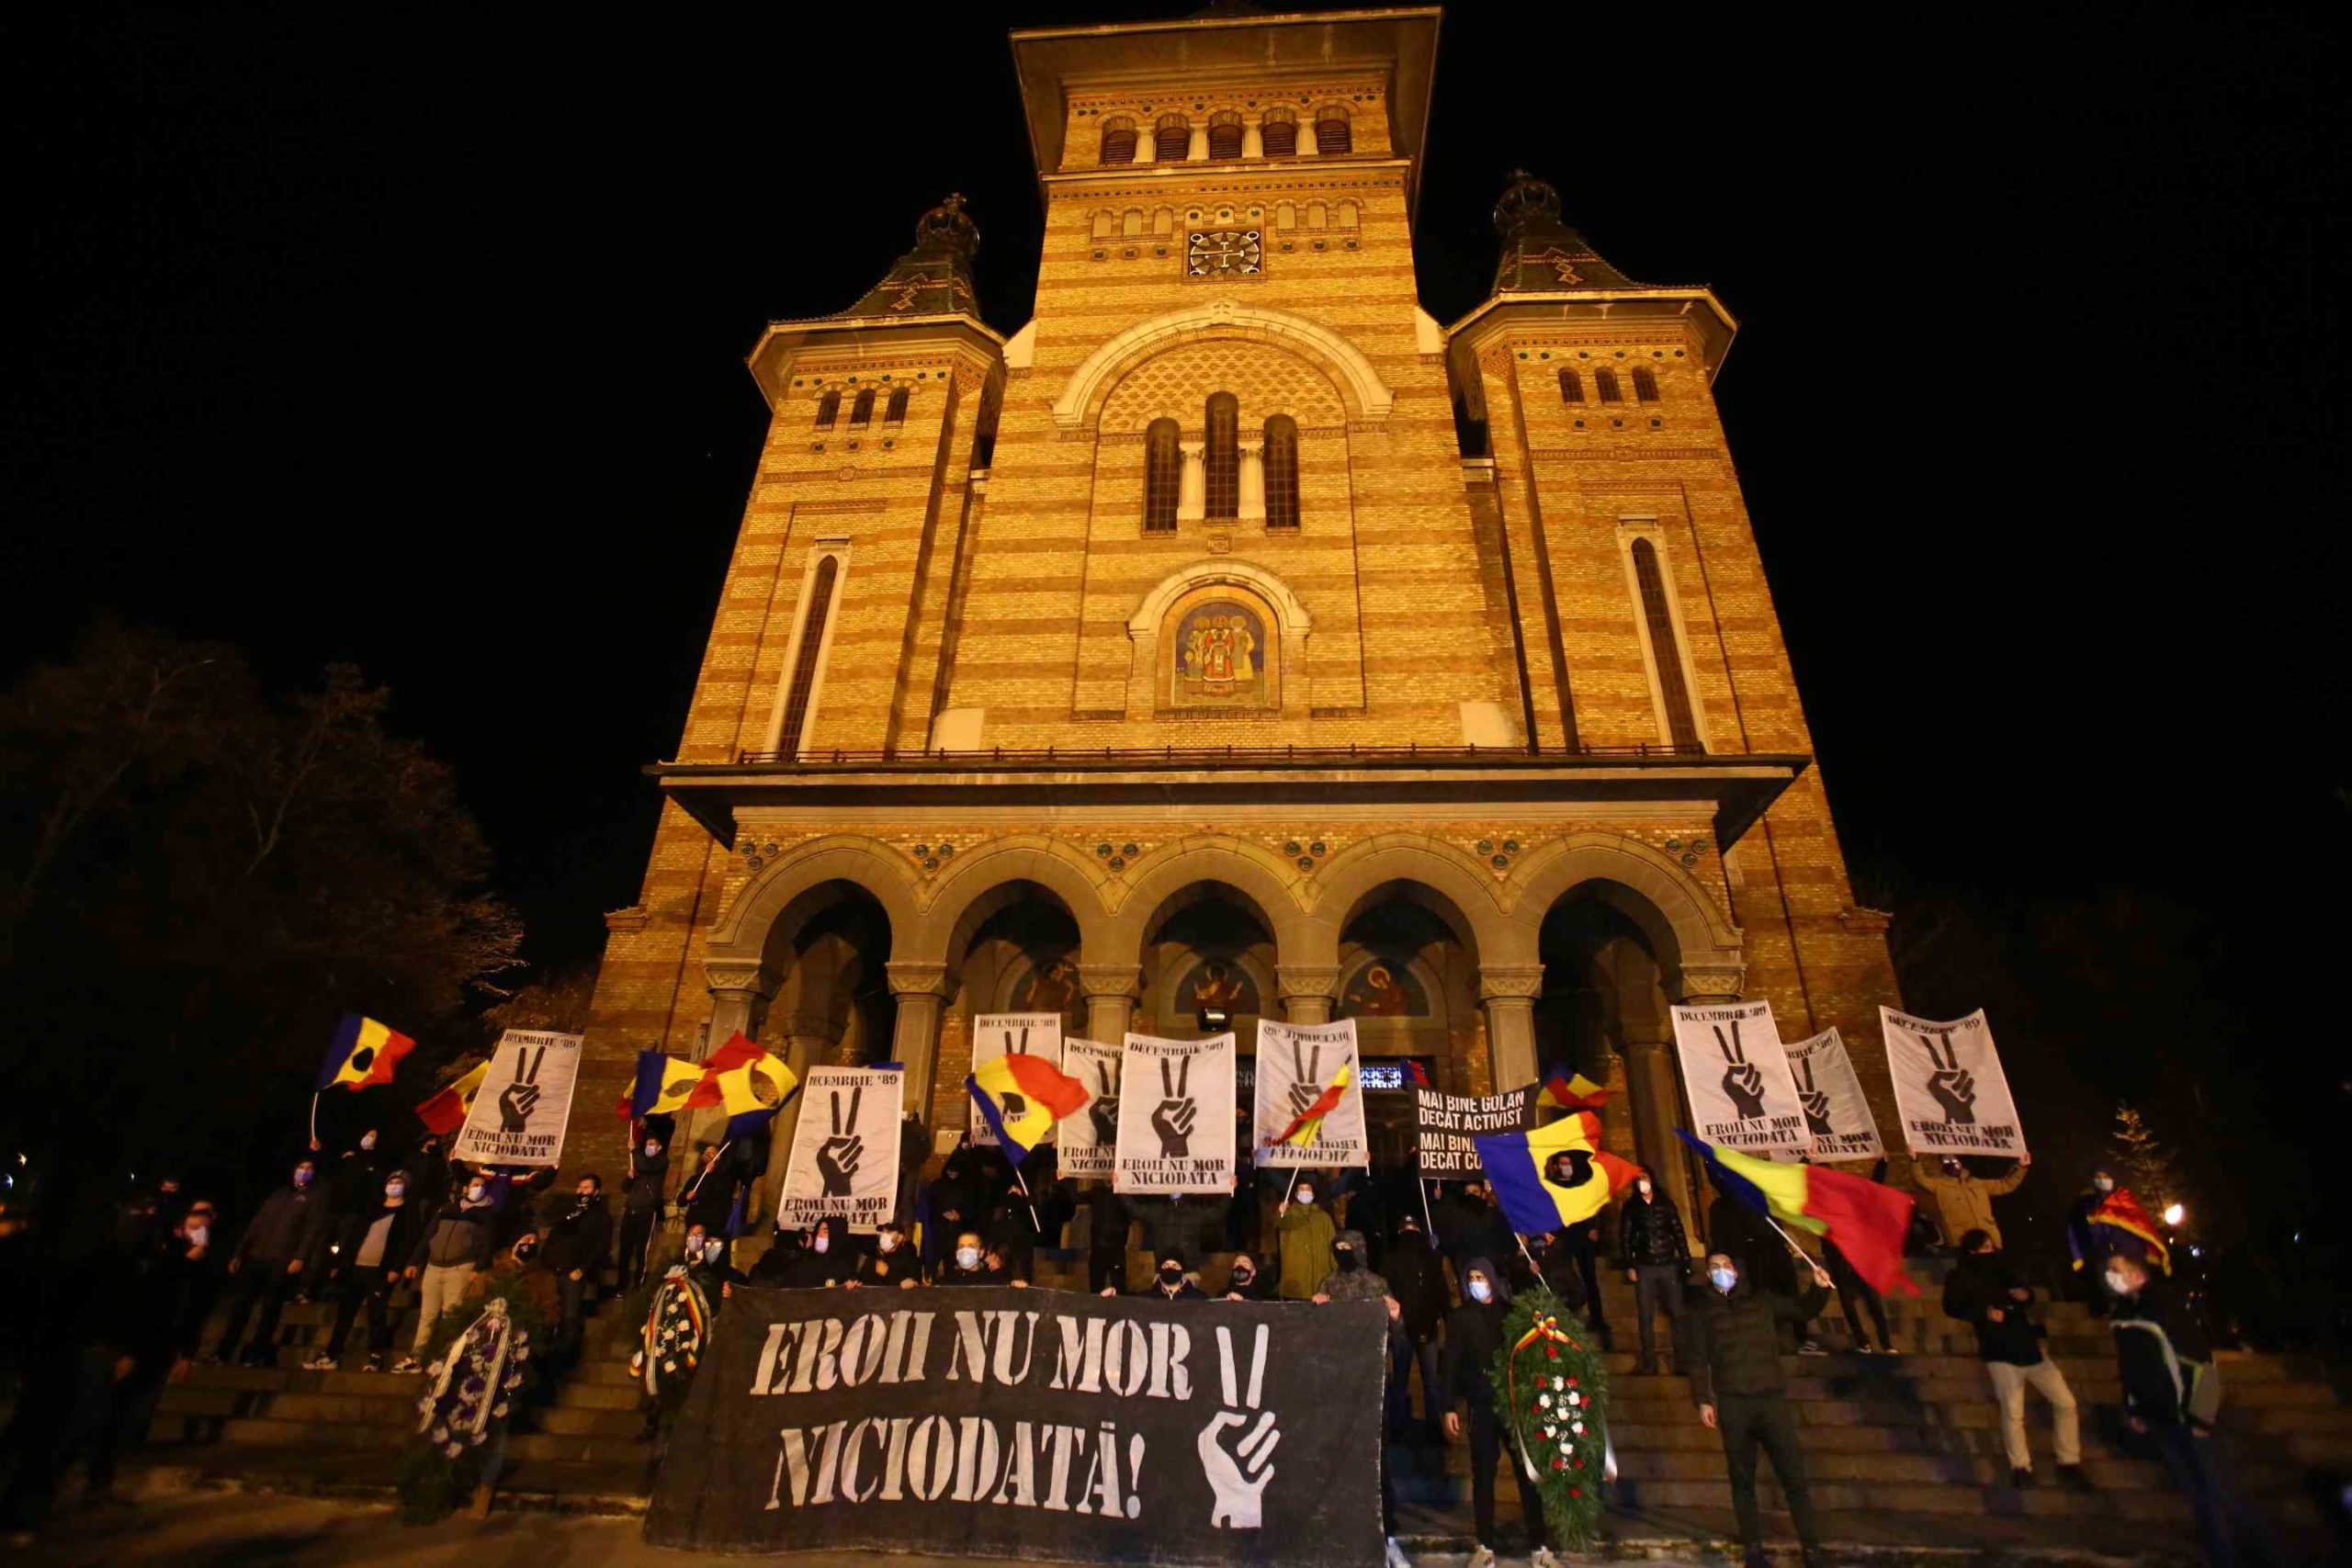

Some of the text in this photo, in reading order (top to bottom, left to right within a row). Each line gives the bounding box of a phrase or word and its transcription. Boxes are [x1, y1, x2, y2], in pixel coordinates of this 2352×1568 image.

[1679, 1010, 1746, 1021] DECEMBRIE
[980, 1019, 1036, 1028] DECEMBRIE
[809, 1075, 898, 1087] DECEMBRIE '89
[1418, 1089, 1524, 1112] MAI BINE GOLAN
[1464, 1108, 1523, 1131] ACTIVIST
[1705, 1116, 1802, 1135] EROII NU MOR
[467, 1128, 556, 1146] EROII NU MOR
[1956, 1124, 1975, 1134] NU
[1980, 1125, 2014, 1137] MOR
[1420, 1133, 1445, 1150] MAI
[1839, 1132, 1872, 1144] MOR
[471, 1142, 547, 1156] NICIODATA
[1063, 1146, 1098, 1157] EROII
[1123, 1159, 1225, 1171] EROII NU MOR
[1132, 1171, 1218, 1185] NICIODATA
[785, 1197, 888, 1212] EROII NU MOR
[750, 1310, 1193, 1401] EROII NU MOR
